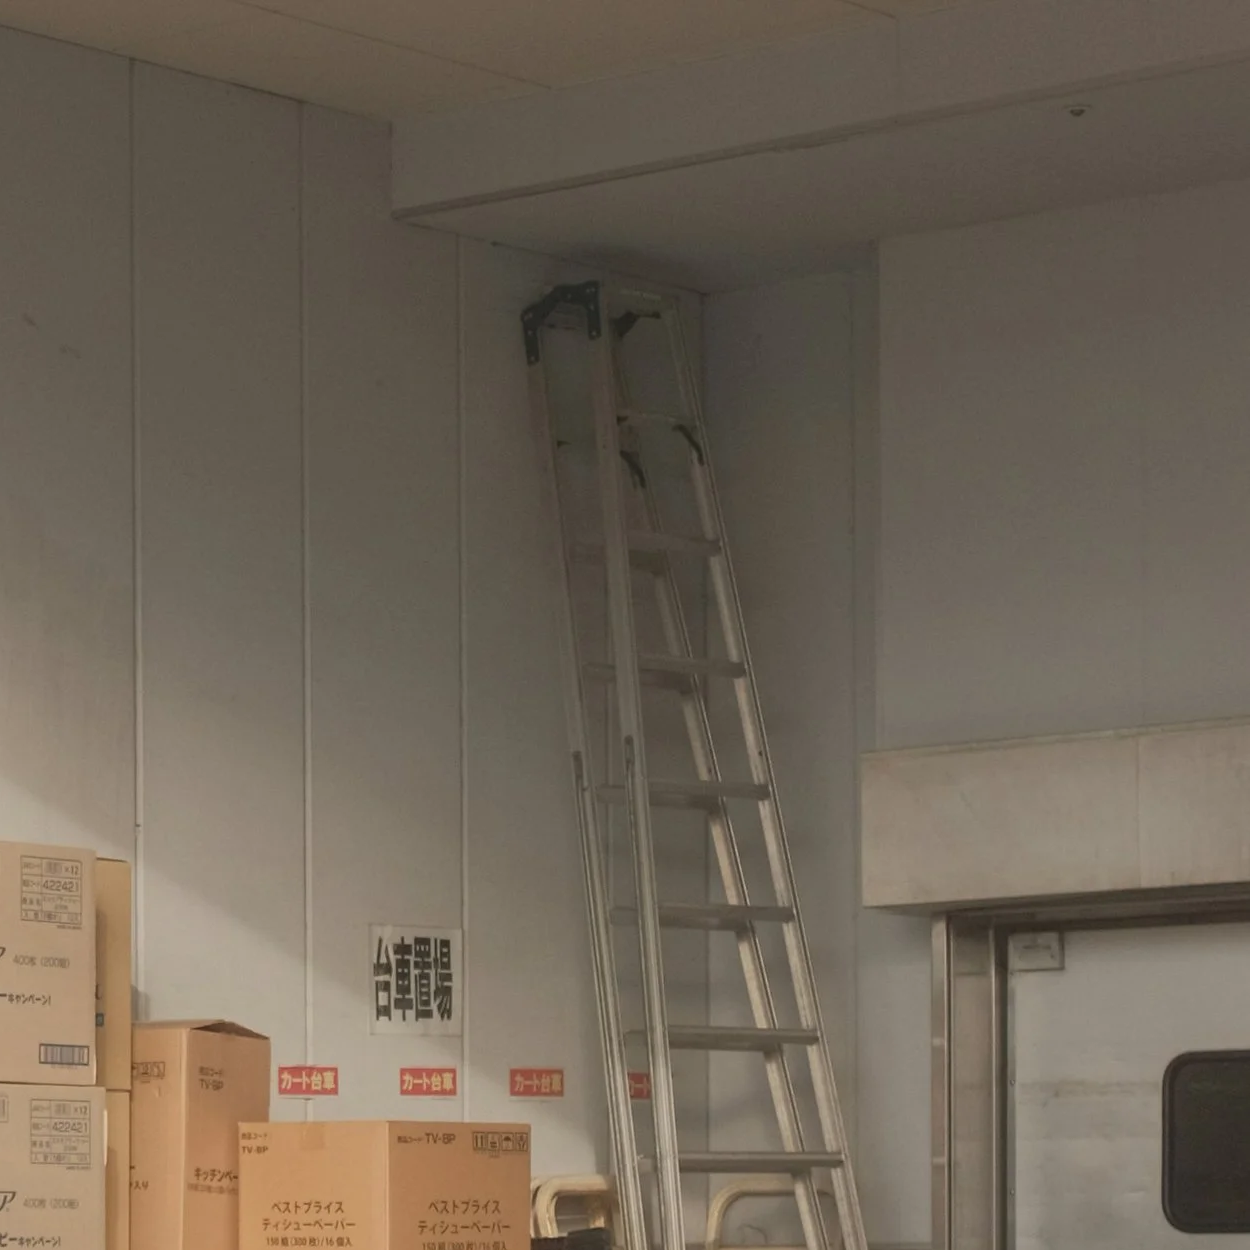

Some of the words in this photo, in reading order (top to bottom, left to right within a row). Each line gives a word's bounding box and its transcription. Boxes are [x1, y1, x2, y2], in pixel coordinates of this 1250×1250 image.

[43, 879, 80, 892] 422421
[281, 1072, 335, 1091] カート台車
[402, 1073, 454, 1091] カート台車
[514, 1074, 562, 1092] カート台車
[52, 1121, 88, 1133] 422421
[271, 1201, 344, 1214] ベストプライス
[428, 1200, 501, 1214] ベストプライス
